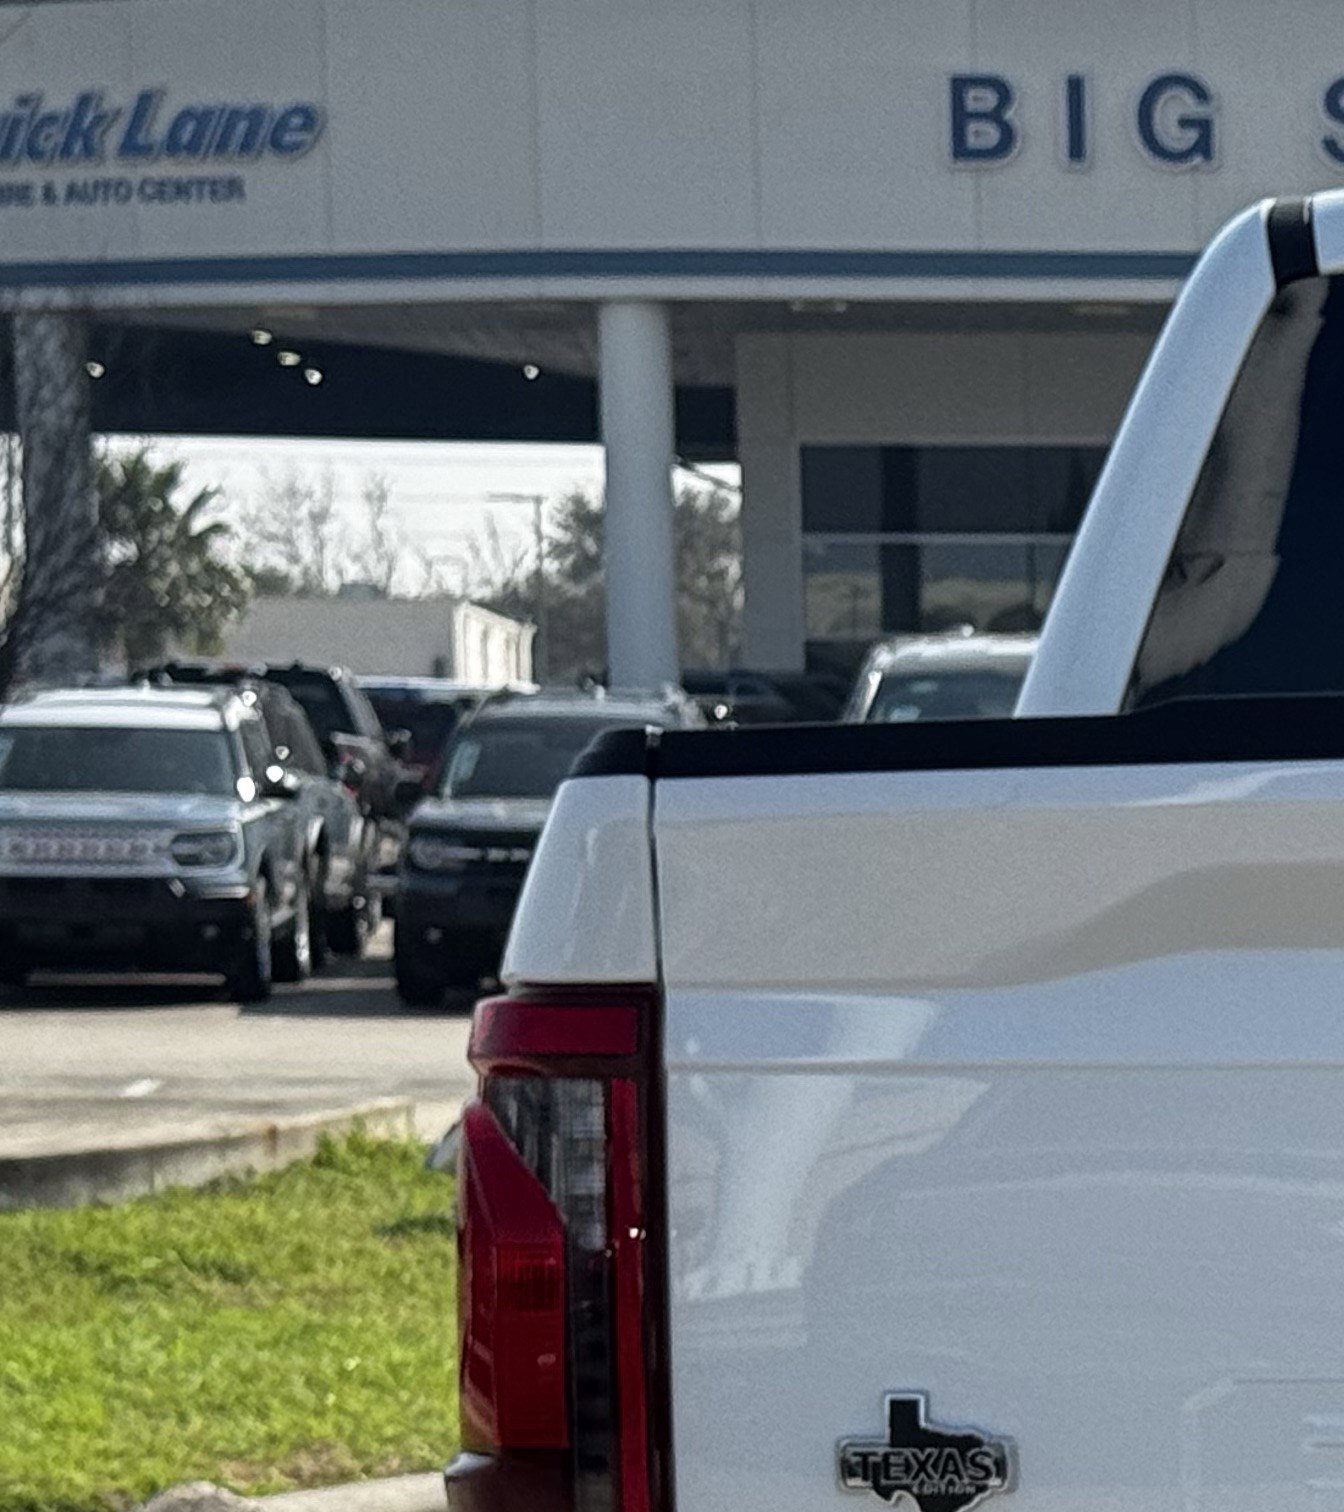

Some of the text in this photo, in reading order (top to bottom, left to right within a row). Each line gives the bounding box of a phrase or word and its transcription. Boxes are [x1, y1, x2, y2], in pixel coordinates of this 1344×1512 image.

[0, 87, 323, 162] ick Lane
[948, 73, 1216, 165] BIG
[63, 177, 132, 206] AUTO
[137, 174, 246, 204] CENTER
[850, 1448, 996, 1484] TEXAS
